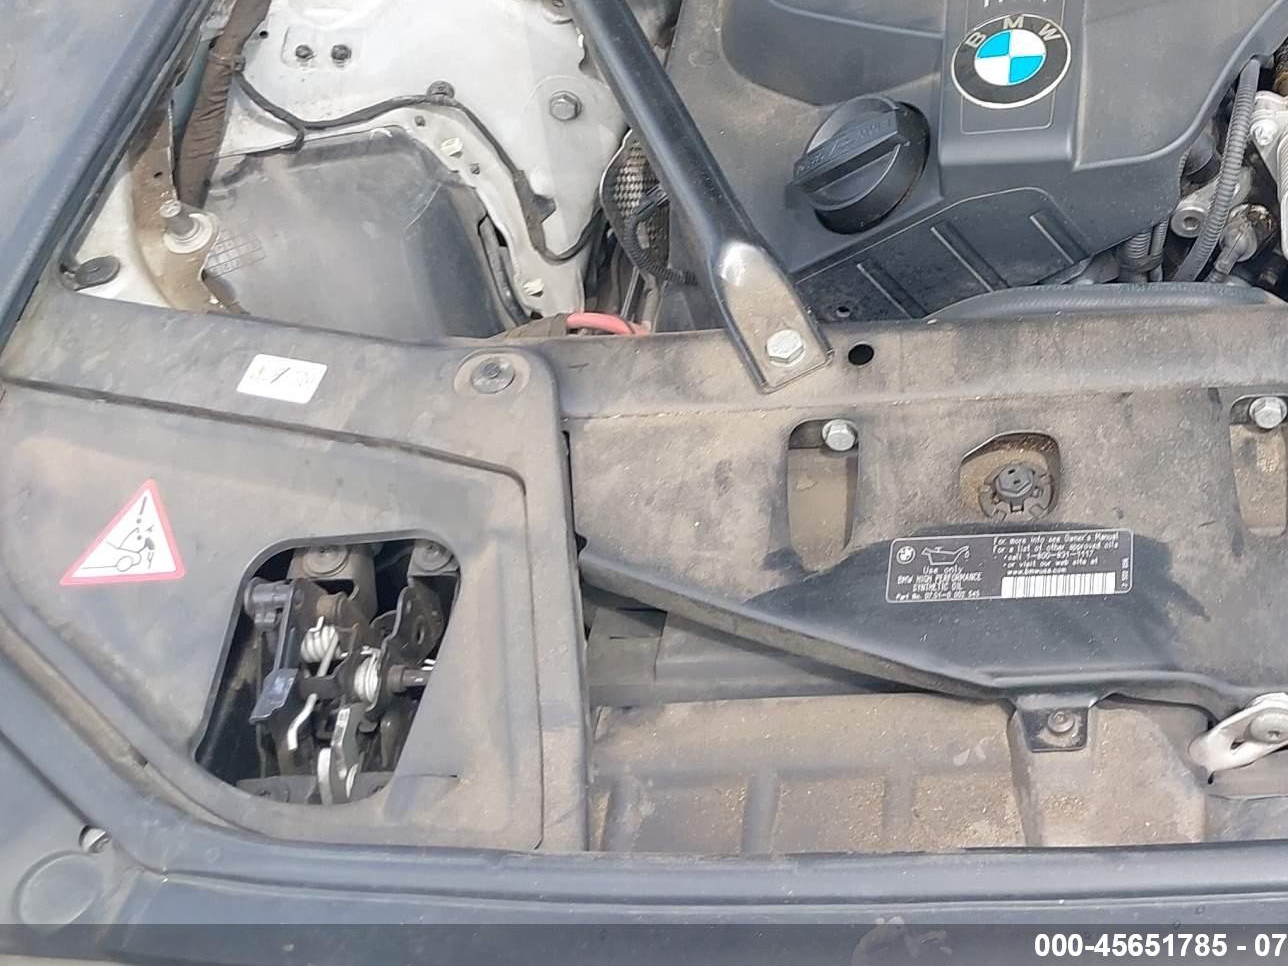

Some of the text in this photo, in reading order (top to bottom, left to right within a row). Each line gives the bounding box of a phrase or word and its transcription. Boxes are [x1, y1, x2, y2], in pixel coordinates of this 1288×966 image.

[965, 15, 1061, 48] BMW
[993, 536, 1006, 545] For
[1009, 537, 1026, 545] more
[1094, 532, 1119, 542] Manual
[992, 544, 1006, 554] For
[1046, 542, 1065, 552] other
[923, 564, 964, 575] Use only
